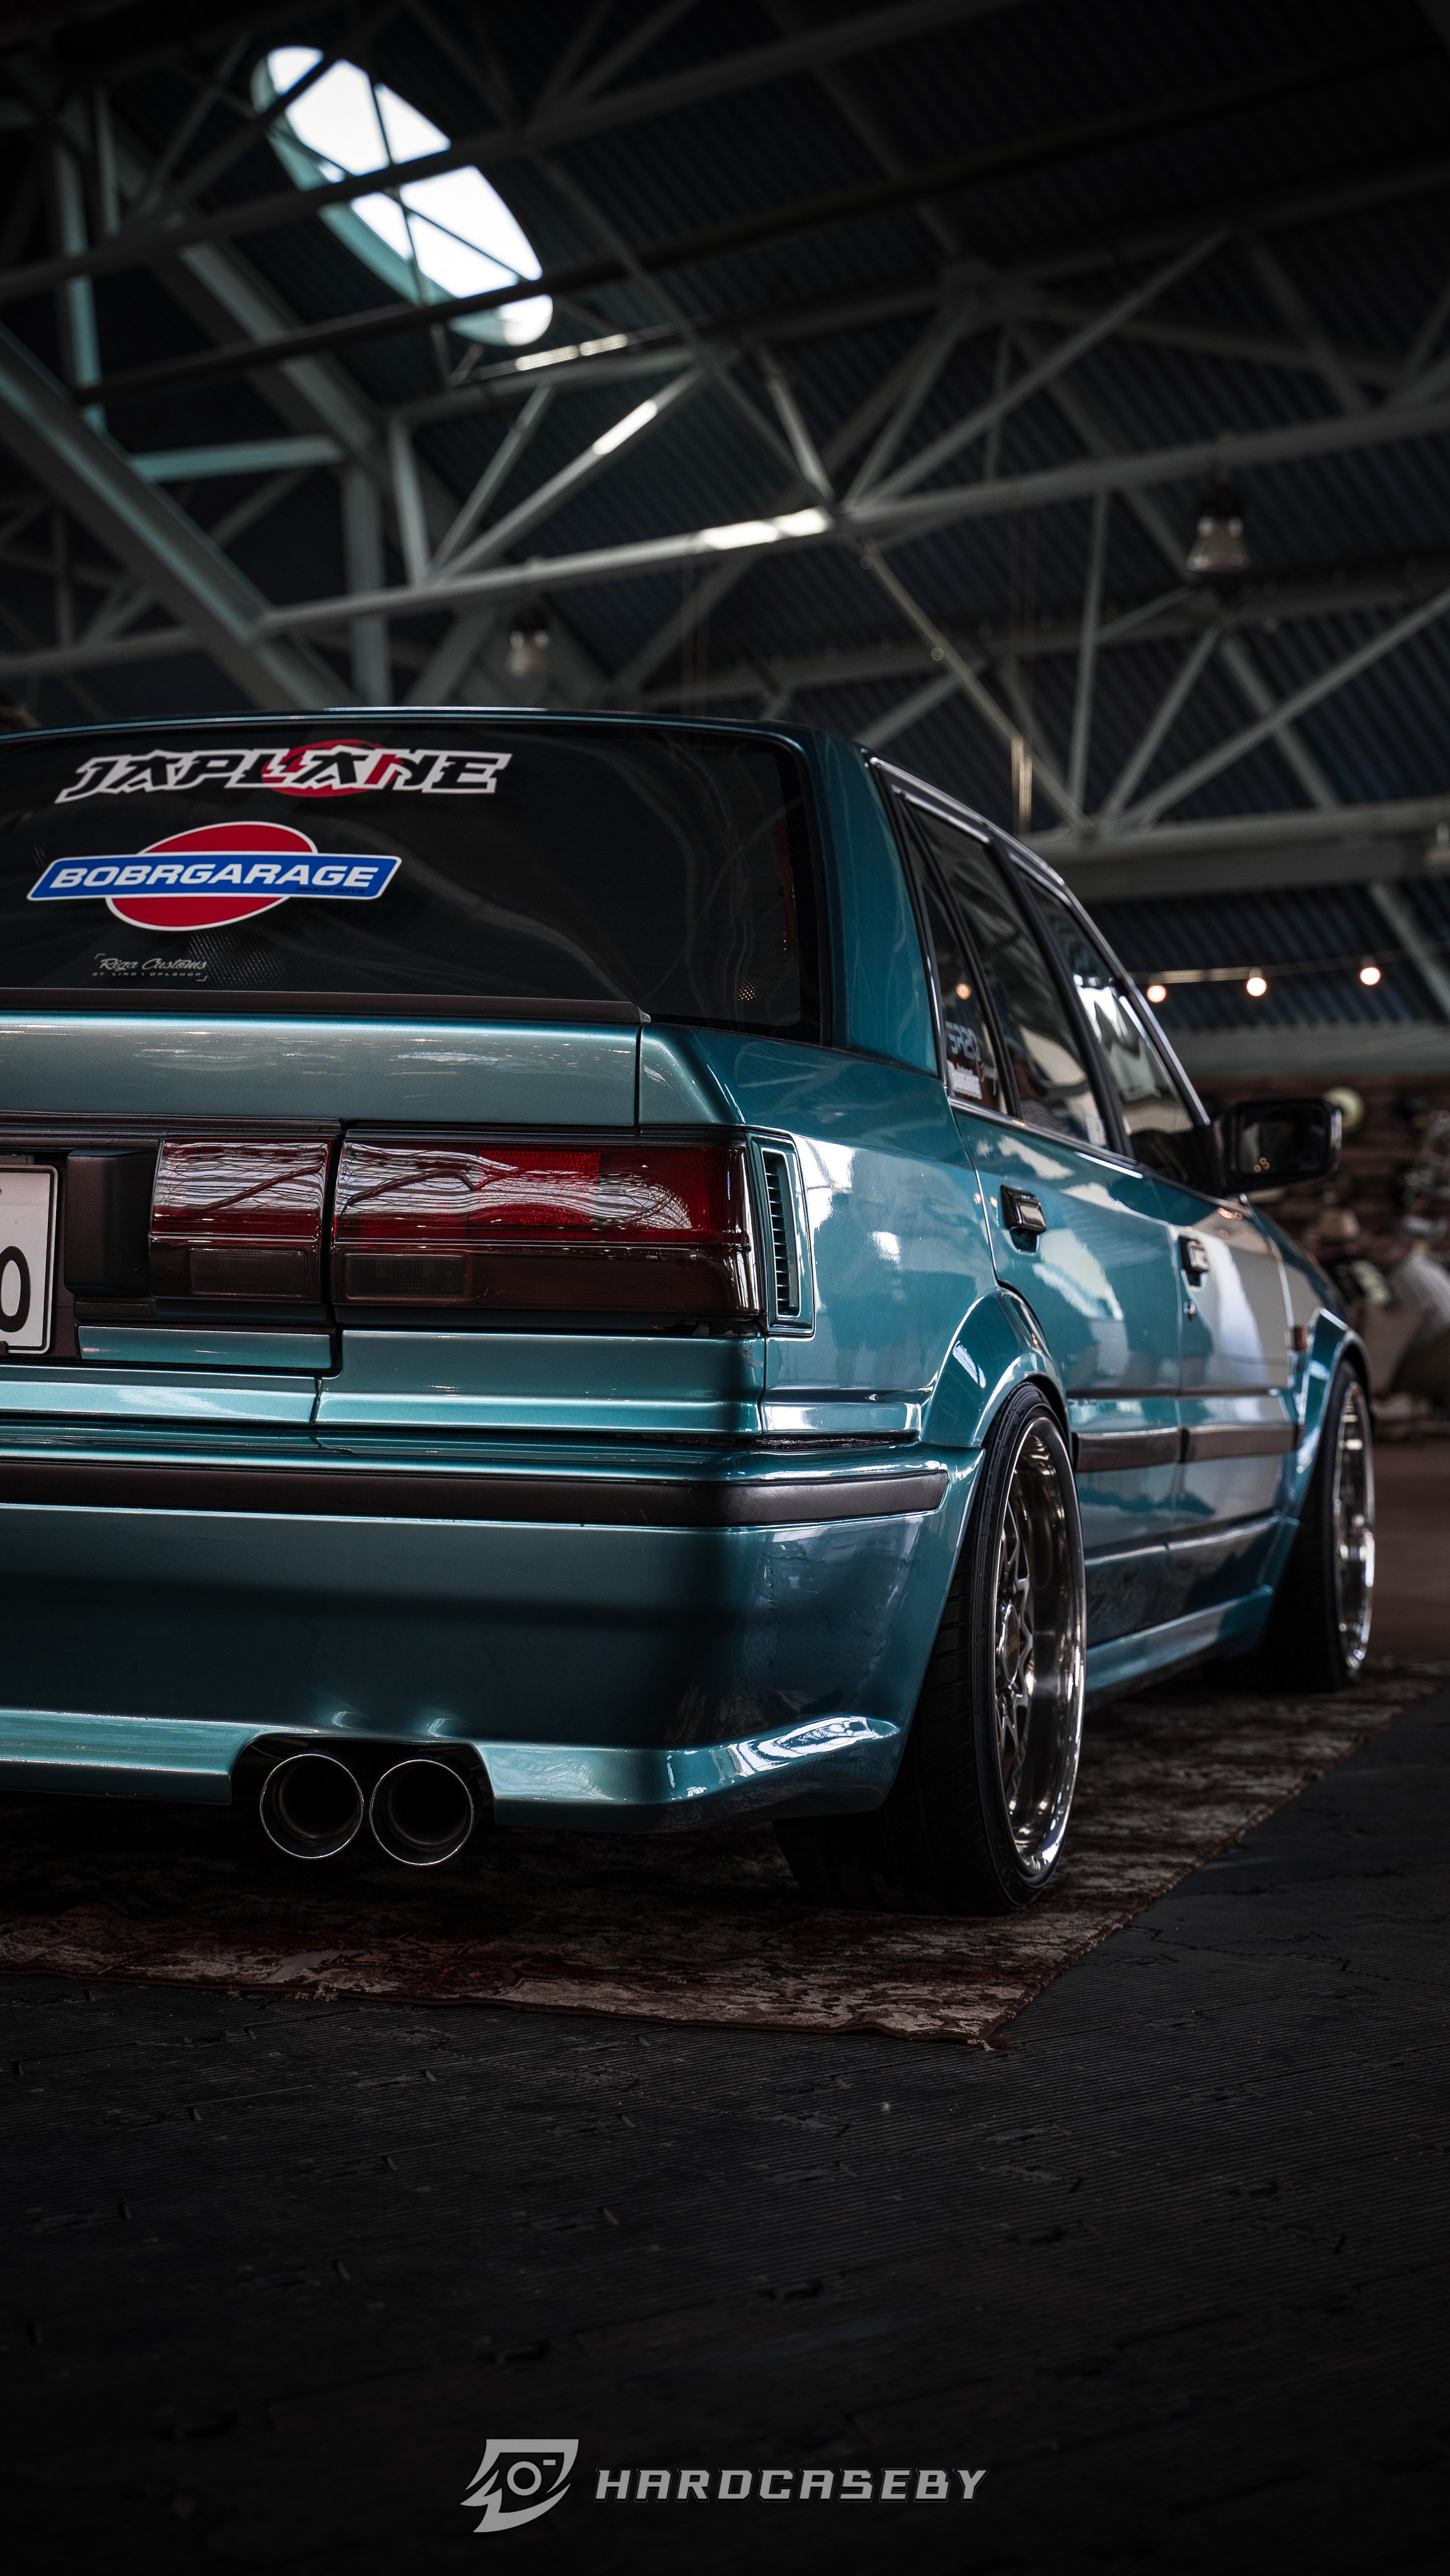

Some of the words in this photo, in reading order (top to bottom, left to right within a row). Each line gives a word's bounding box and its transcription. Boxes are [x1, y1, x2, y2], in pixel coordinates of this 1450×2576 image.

[54, 745, 513, 804] JAPLANE
[49, 863, 380, 888] BOBRGARAGE
[99, 958, 139, 972] Riga
[142, 958, 207, 970] Customs
